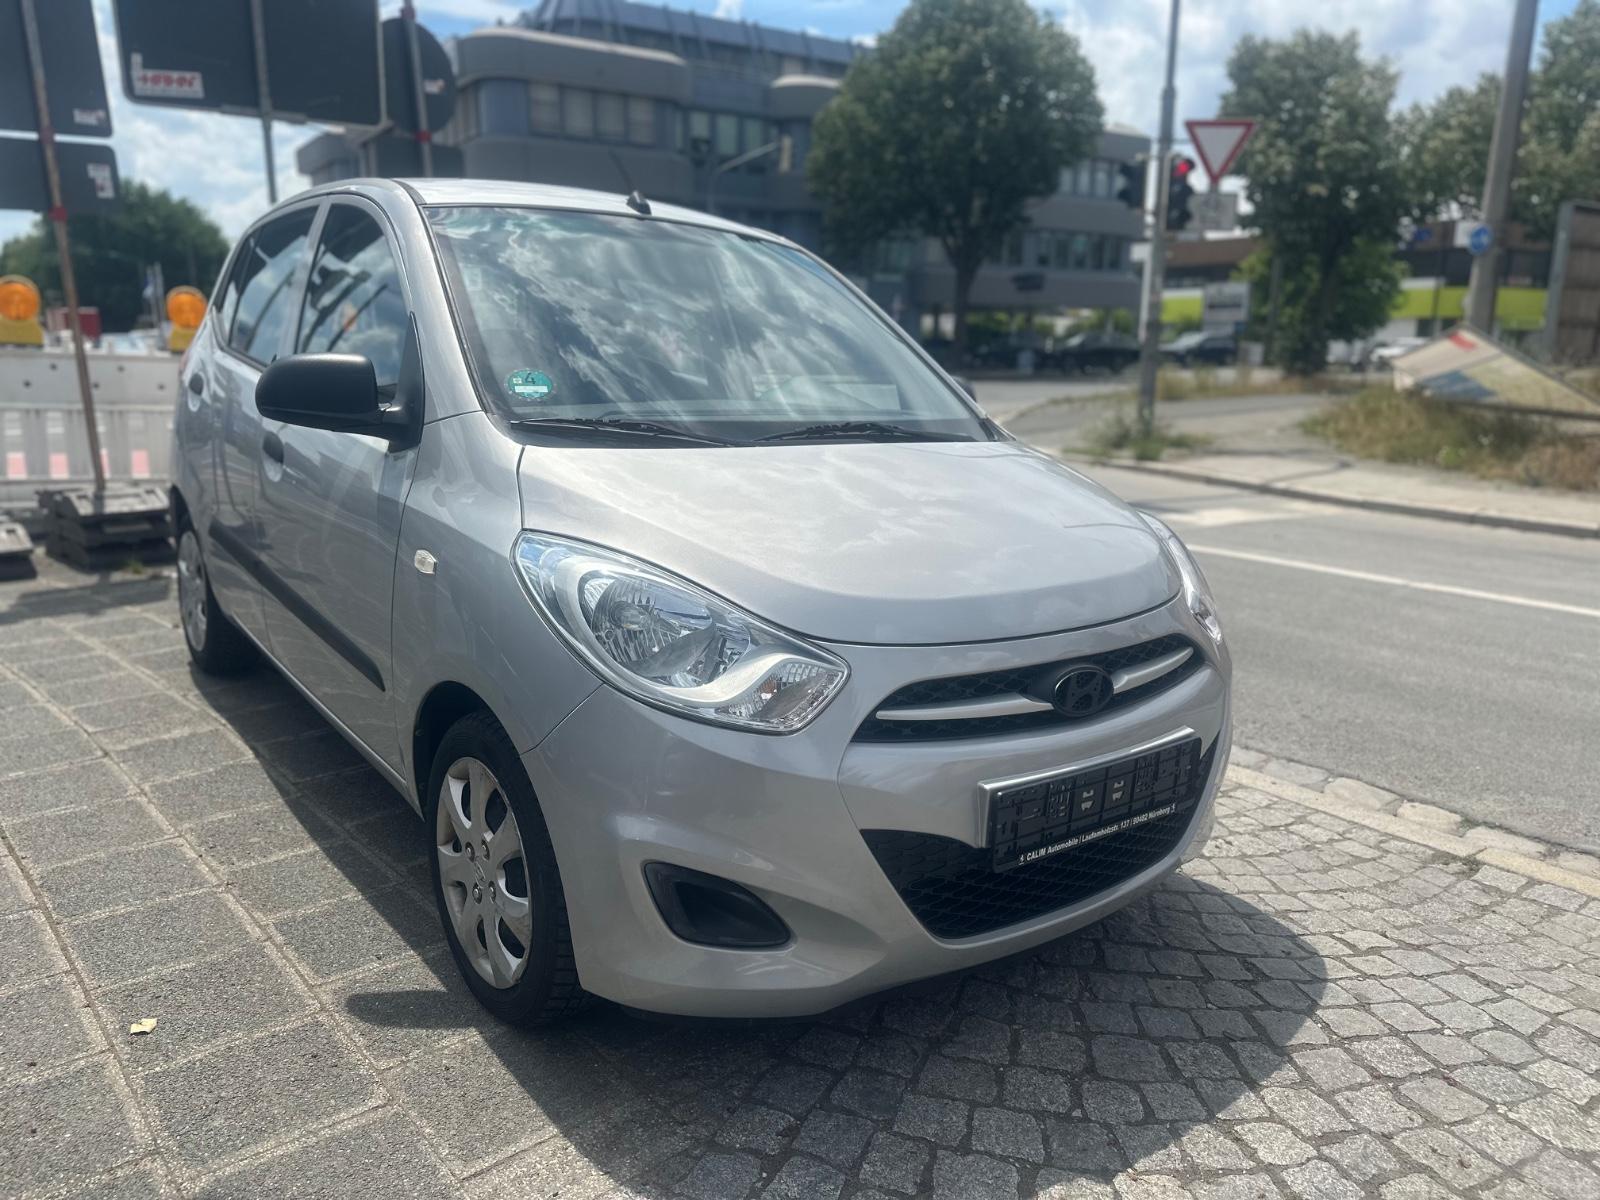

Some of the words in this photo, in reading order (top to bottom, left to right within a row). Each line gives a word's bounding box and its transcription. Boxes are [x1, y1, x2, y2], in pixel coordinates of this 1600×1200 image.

[525, 372, 537, 384] 4
[1026, 847, 1046, 861] CALIM
[1047, 838, 1079, 854] Automobile
